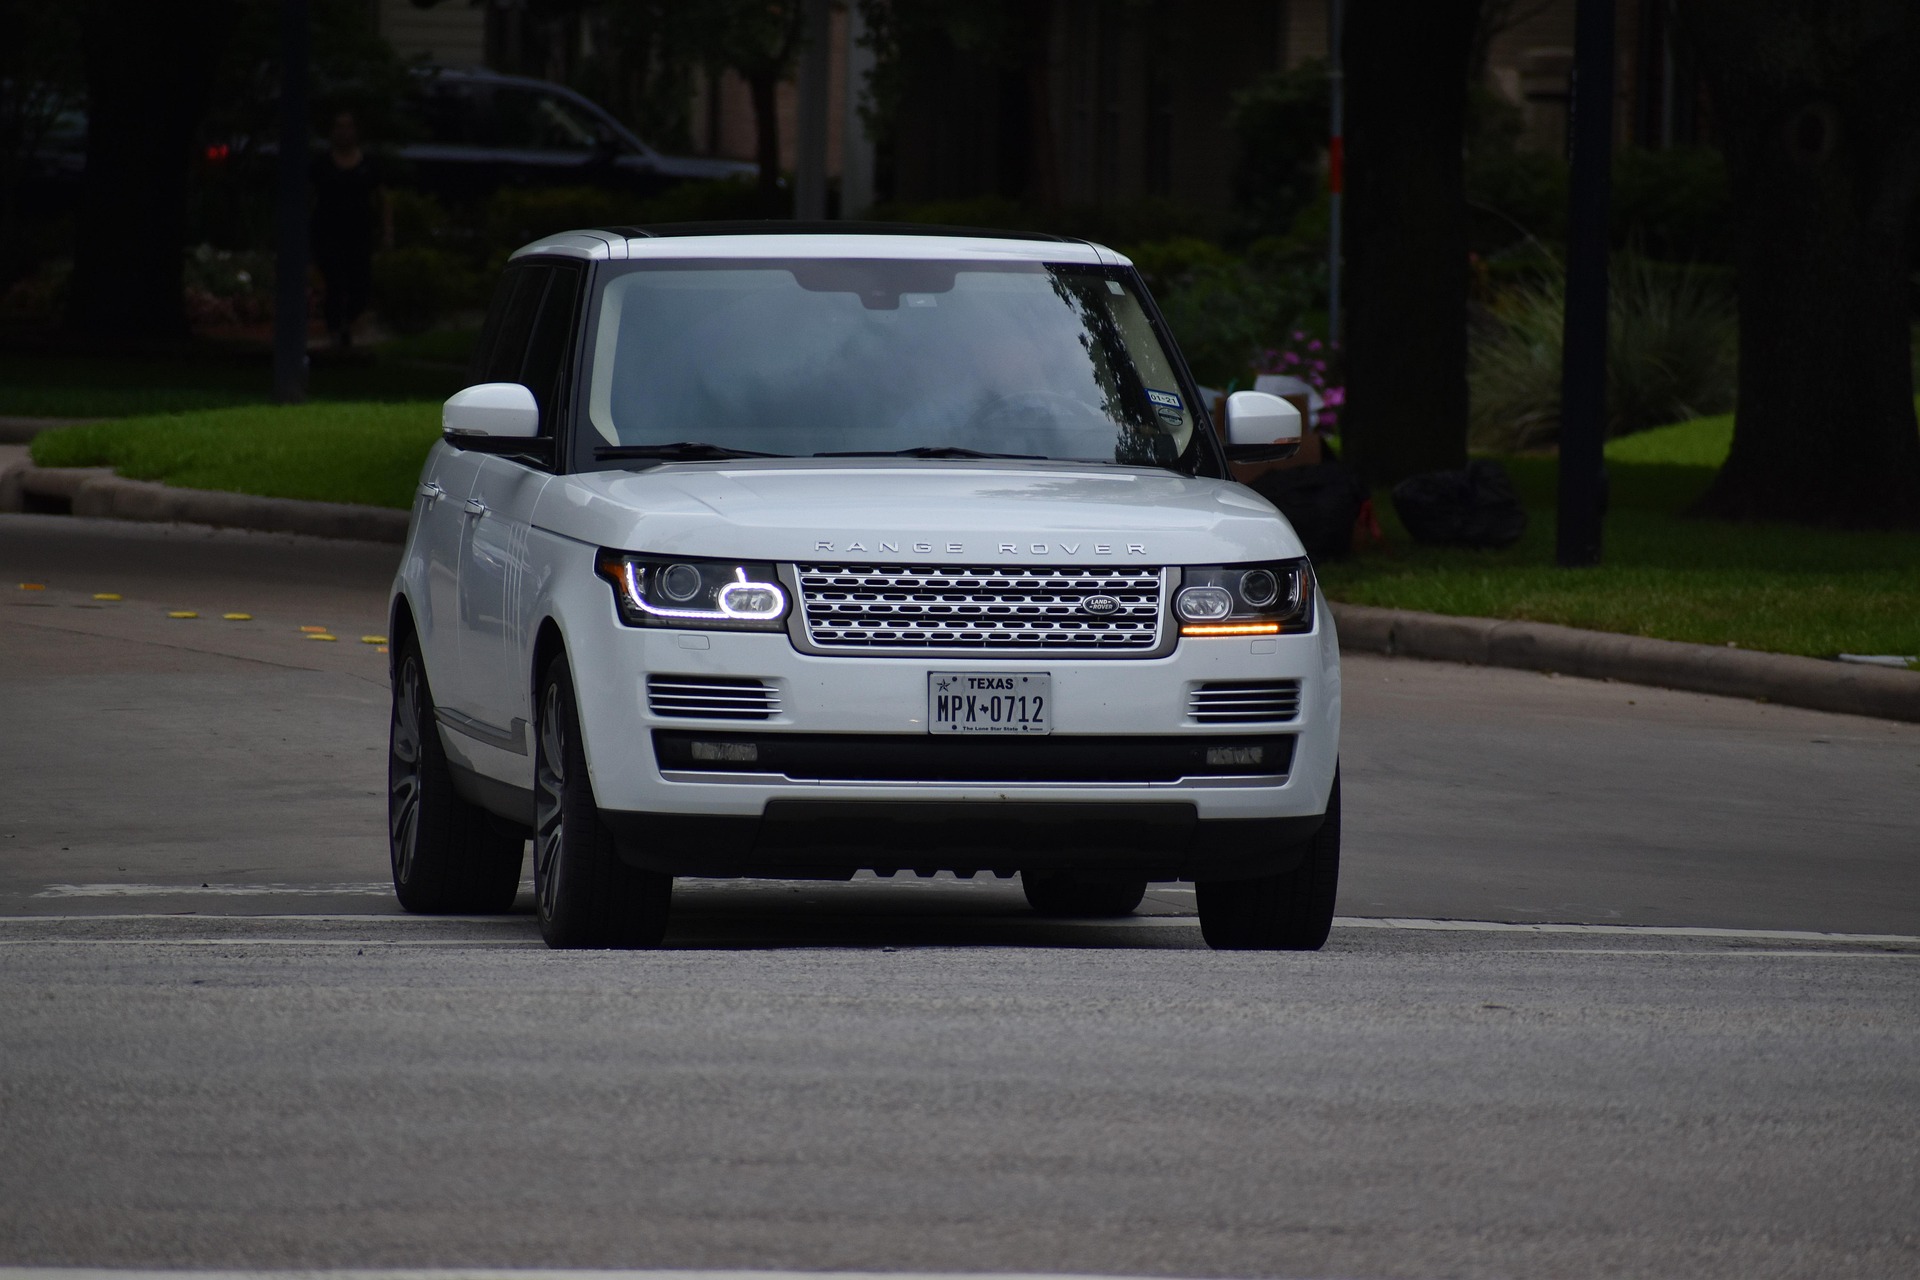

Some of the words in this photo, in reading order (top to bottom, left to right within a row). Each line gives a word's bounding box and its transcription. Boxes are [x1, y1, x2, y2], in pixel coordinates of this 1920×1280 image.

[814, 540, 964, 554] RANGE
[998, 542, 1147, 555] ROVER
[968, 678, 1014, 690] TEXAS
